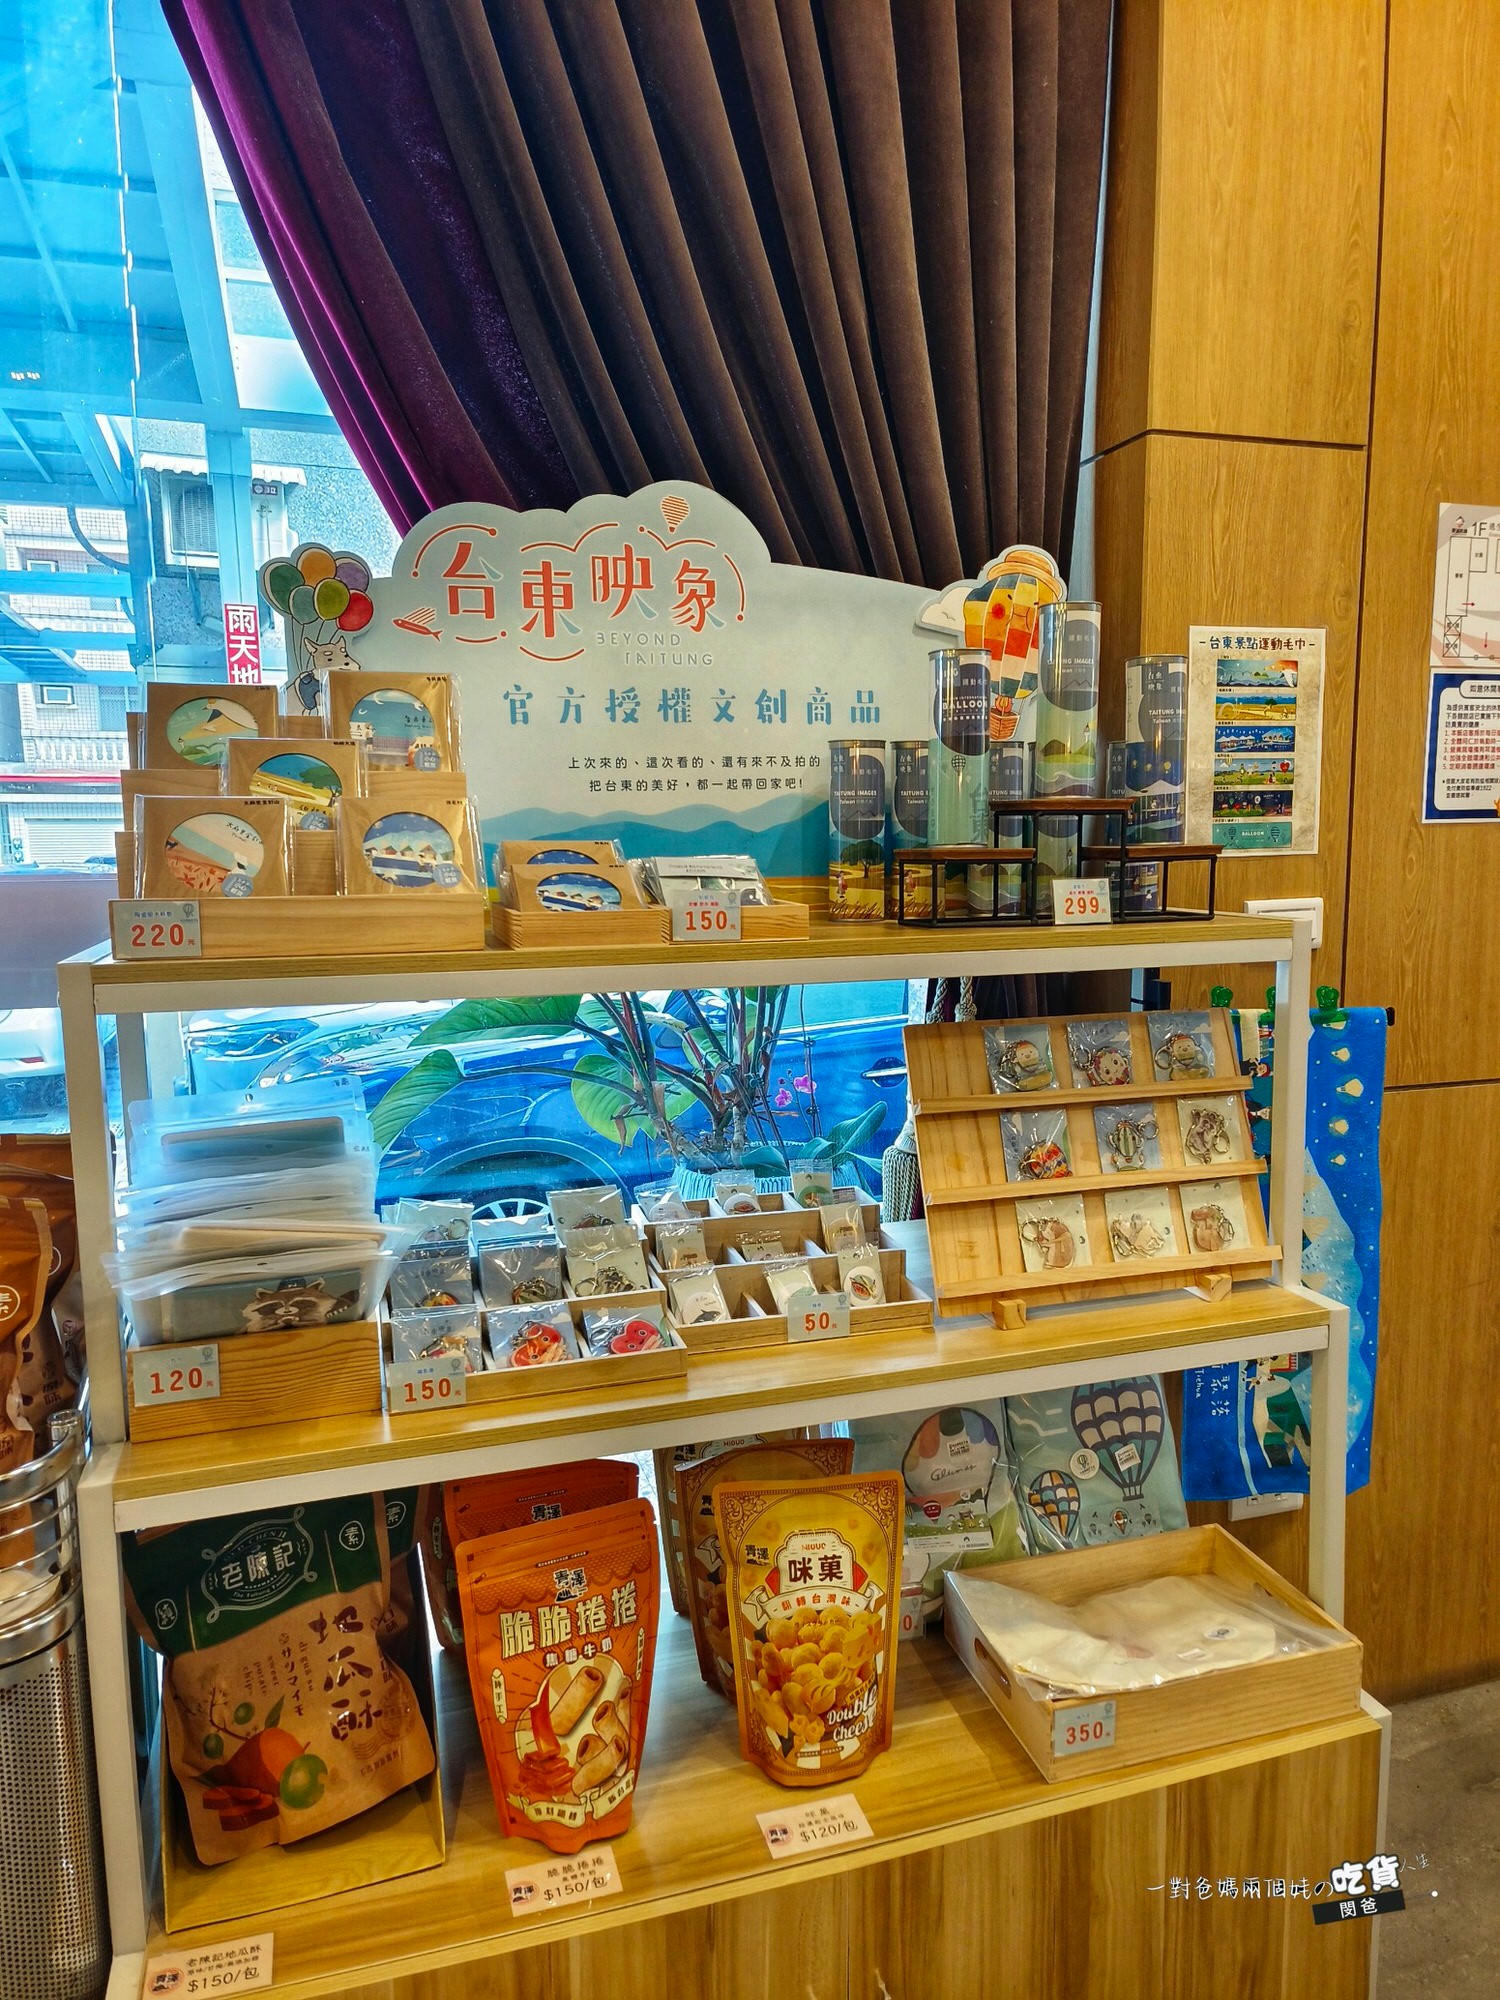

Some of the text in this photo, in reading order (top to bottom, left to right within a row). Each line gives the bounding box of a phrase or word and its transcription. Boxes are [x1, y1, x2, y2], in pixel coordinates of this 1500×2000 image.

[442, 541, 727, 640] 台東映象
[226, 605, 259, 684] 雨天地
[596, 631, 682, 647] BEYOND
[624, 651, 714, 666] TAITUNG
[503, 683, 881, 726] 官方授權文創商品
[568, 754, 821, 770] 上次來的、這次看的、還有來不及拍的
[220, 1539, 296, 1591] 老陳記
[553, 1568, 587, 1587] 青澤
[787, 1554, 844, 1584] 咪菓
[500, 1580, 638, 1660] 脆脆捲捲
[545, 1637, 613, 1668] 焦糖牛奶
[307, 1605, 383, 1742] 地瓜酥
[826, 1684, 878, 1726] Double
[800, 1819, 858, 1844] $120/包
[543, 1875, 608, 1901] $150/包
[187, 1966, 260, 1993] $150/包
